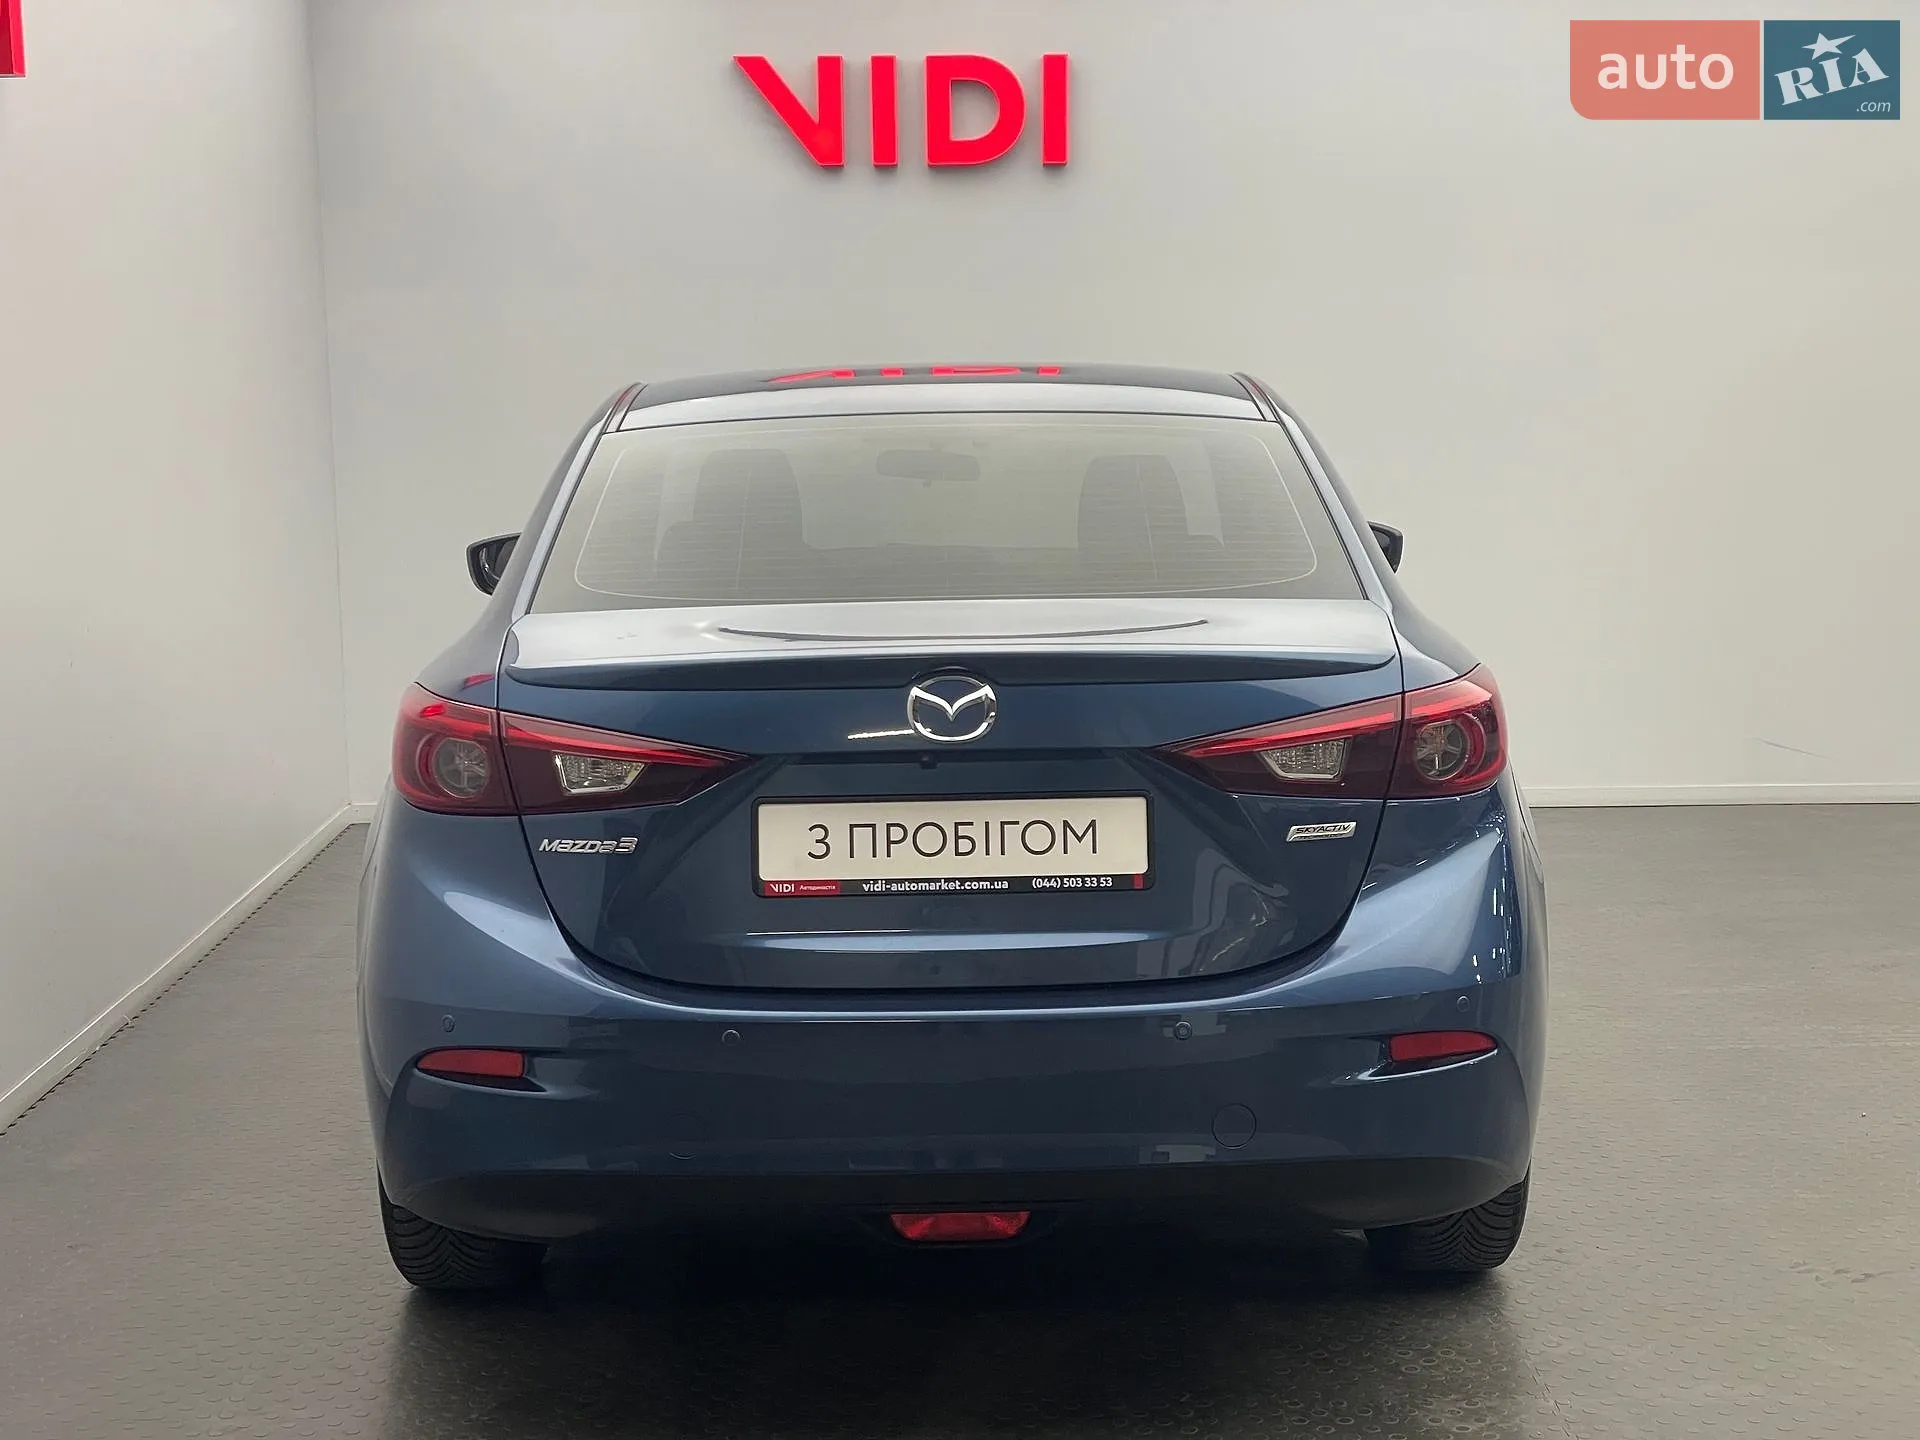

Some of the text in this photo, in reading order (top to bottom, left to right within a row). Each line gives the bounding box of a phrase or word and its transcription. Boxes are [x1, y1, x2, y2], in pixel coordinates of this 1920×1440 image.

[732, 53, 1070, 167] VIDI
[1296, 824, 1352, 834] SKYACTIV
[848, 818, 1098, 859] ПРОБІГОМ
[769, 883, 795, 893] VIDI
[862, 879, 1009, 892] vidi-automarket.com.ua
[1032, 876, 1113, 889] (044) 503 33 53
